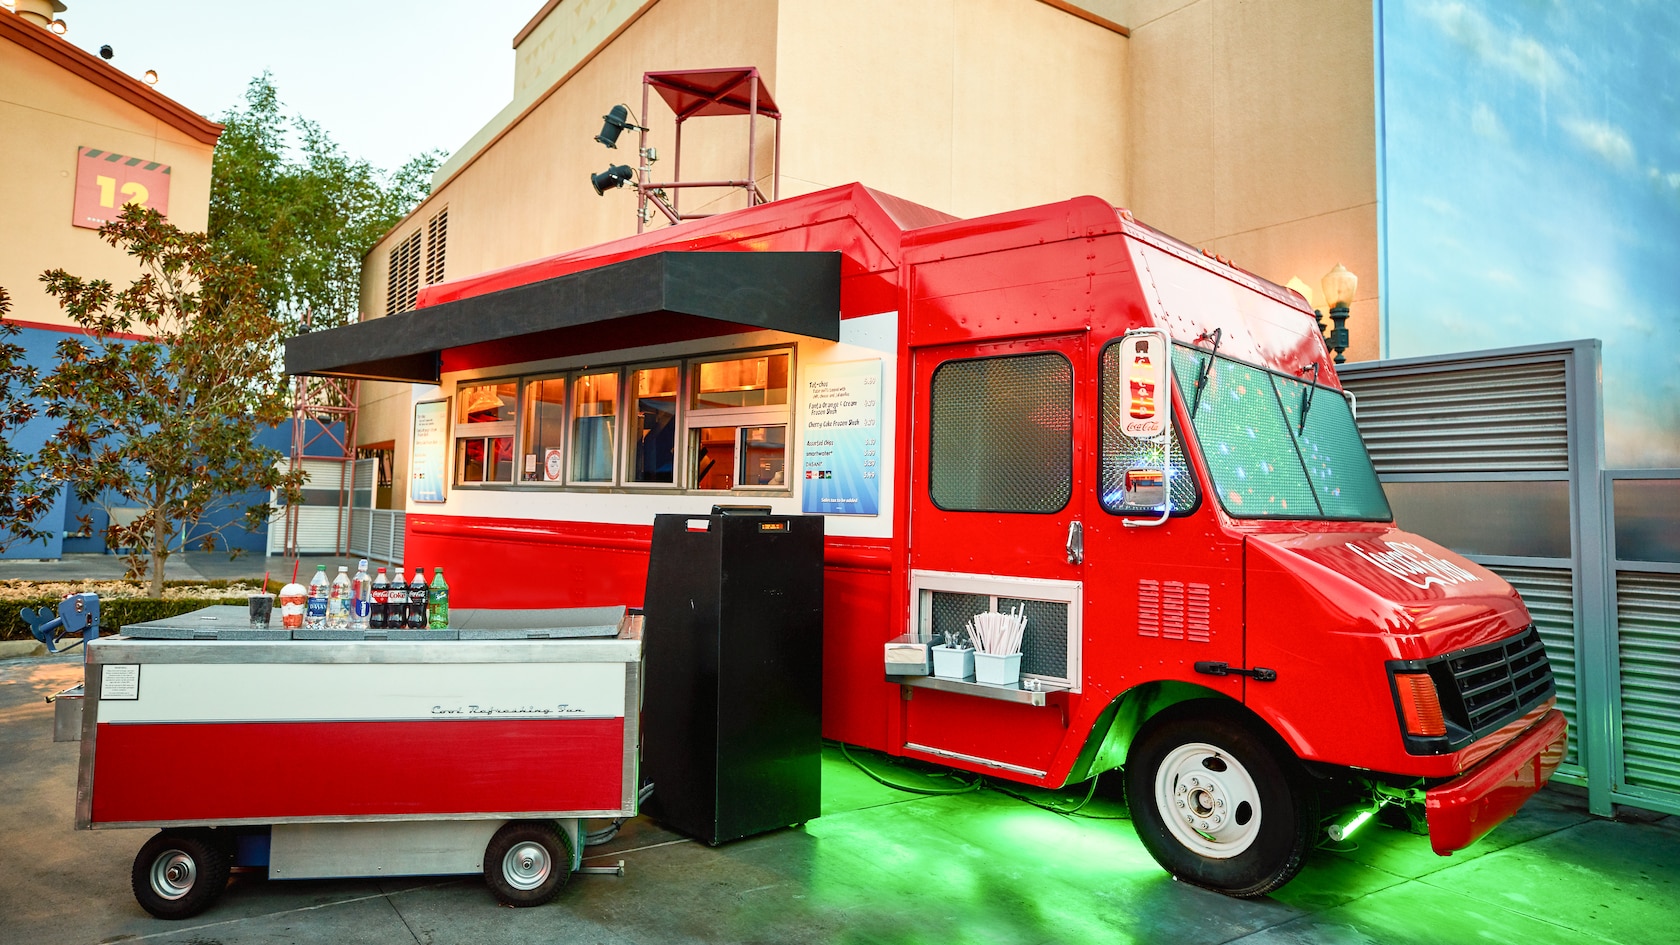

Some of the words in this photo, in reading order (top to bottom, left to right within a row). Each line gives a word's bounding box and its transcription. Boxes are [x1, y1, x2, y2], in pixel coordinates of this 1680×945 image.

[96, 175, 149, 215] 12
[822, 401, 839, 409] Orange
[1126, 422, 1158, 431] Coca-Cola
[389, 591, 406, 599] Coke
[431, 705, 463, 714] Cool
[468, 705, 553, 715] Refreshing
[557, 704, 585, 713] Fun
